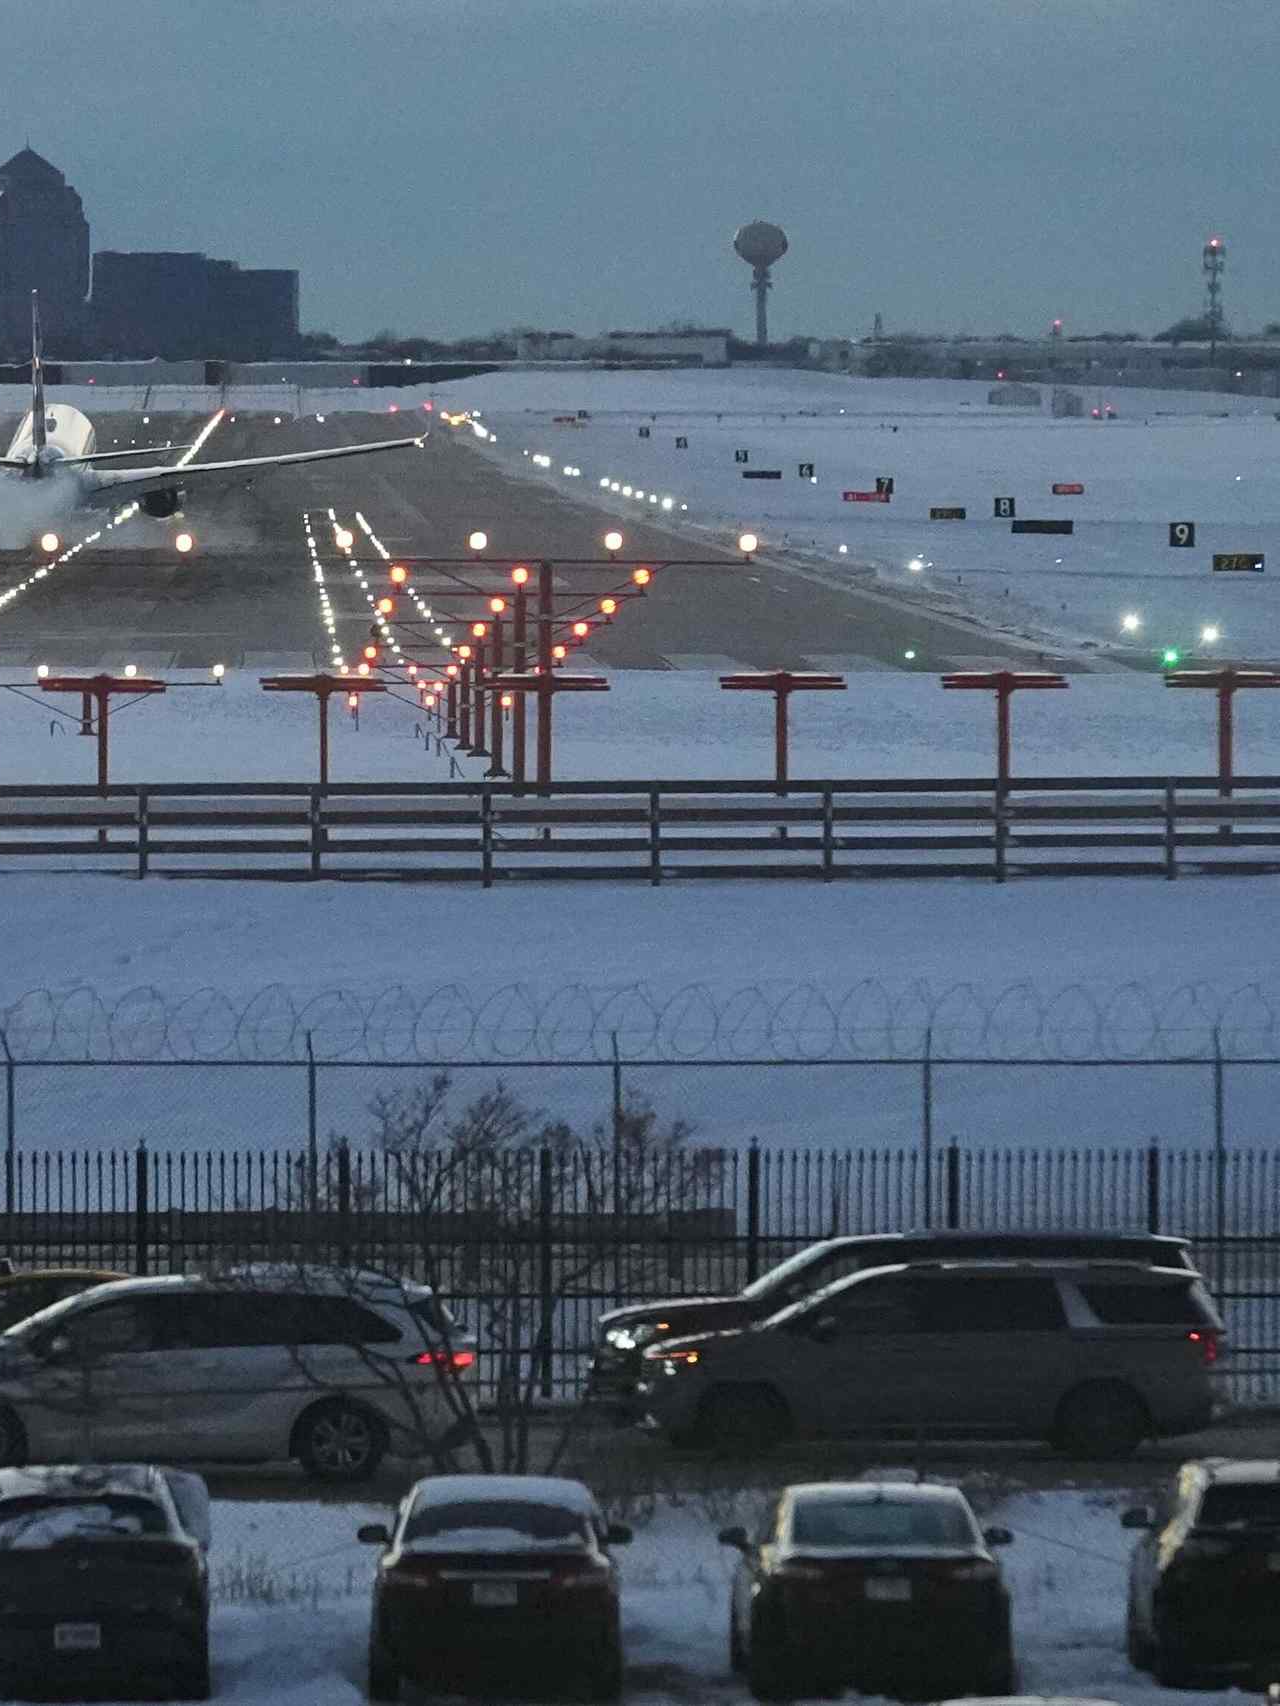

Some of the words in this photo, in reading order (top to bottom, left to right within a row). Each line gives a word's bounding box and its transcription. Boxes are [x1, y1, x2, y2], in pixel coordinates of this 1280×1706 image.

[880, 479, 889, 493] 7
[999, 499, 1011, 516] 8
[1175, 524, 1189, 545] 9
